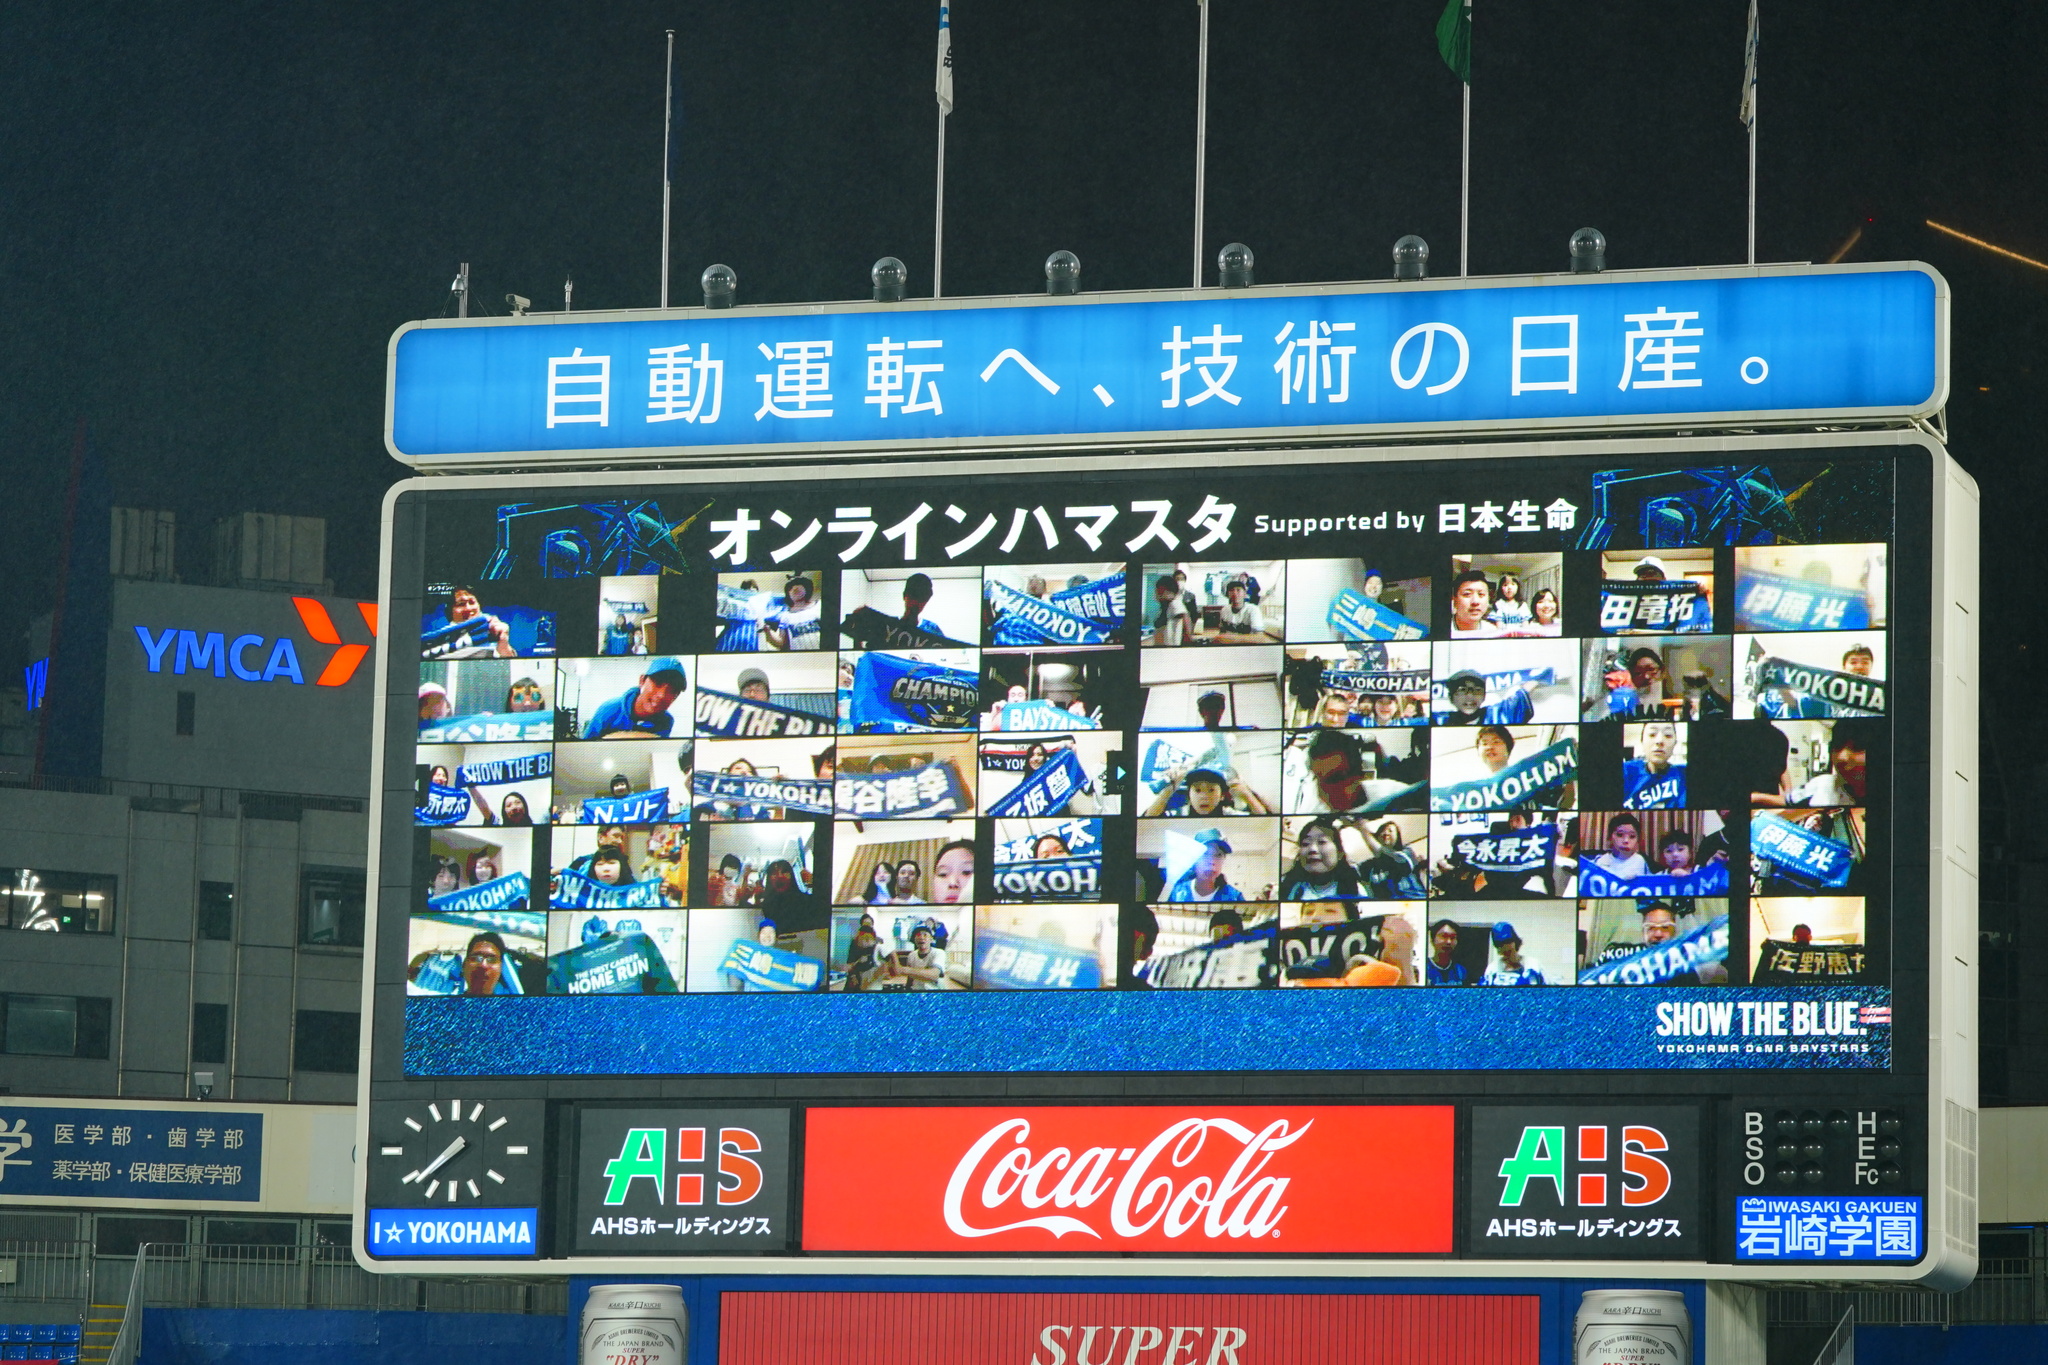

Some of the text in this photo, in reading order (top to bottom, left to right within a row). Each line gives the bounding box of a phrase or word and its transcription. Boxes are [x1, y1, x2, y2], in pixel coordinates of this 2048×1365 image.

[545, 306, 1769, 430] 自動運転へ、技術の日産。
[709, 494, 1578, 565] オンラインハマスタ Supported by 日本生命
[133, 626, 305, 684] YMCA
[892, 677, 979, 707] CHAMPIO
[1783, 666, 1885, 711] YOKOHA
[463, 762, 503, 784] SHOW
[506, 757, 535, 779] THE
[743, 781, 833, 808] YOKOHA
[568, 969, 615, 995] HOME
[616, 957, 650, 982] RUN
[1656, 1001, 1868, 1036] SHOW THE BLUE.
[1656, 1044, 1869, 1053] YOKOHAMA DeNA BAYSTARS
[54, 1123, 244, 1149] 医学部・歯学部
[1745, 1112, 1764, 1135] B
[1857, 1111, 1877, 1134] H
[1745, 1137, 1764, 1160] S
[1858, 1137, 1876, 1160] E
[52, 1160, 242, 1185] 薬学部・保健医療学部
[603, 1127, 763, 1206] AHS
[943, 1117, 1315, 1240] Coca-Cola
[1498, 1125, 1672, 1207] AHS
[1744, 1162, 1765, 1185] O
[1855, 1162, 1879, 1185] Fc
[1768, 1201, 1917, 1213] IWASAKI GAKUEN
[373, 1221, 531, 1244] I YOKOHAMA
[590, 1216, 772, 1236] AHSホールディングス
[1486, 1218, 1682, 1238] AHSホールディングス
[1739, 1213, 1917, 1257] 岩崎学園
[1031, 1325, 1248, 1365] SUPER
